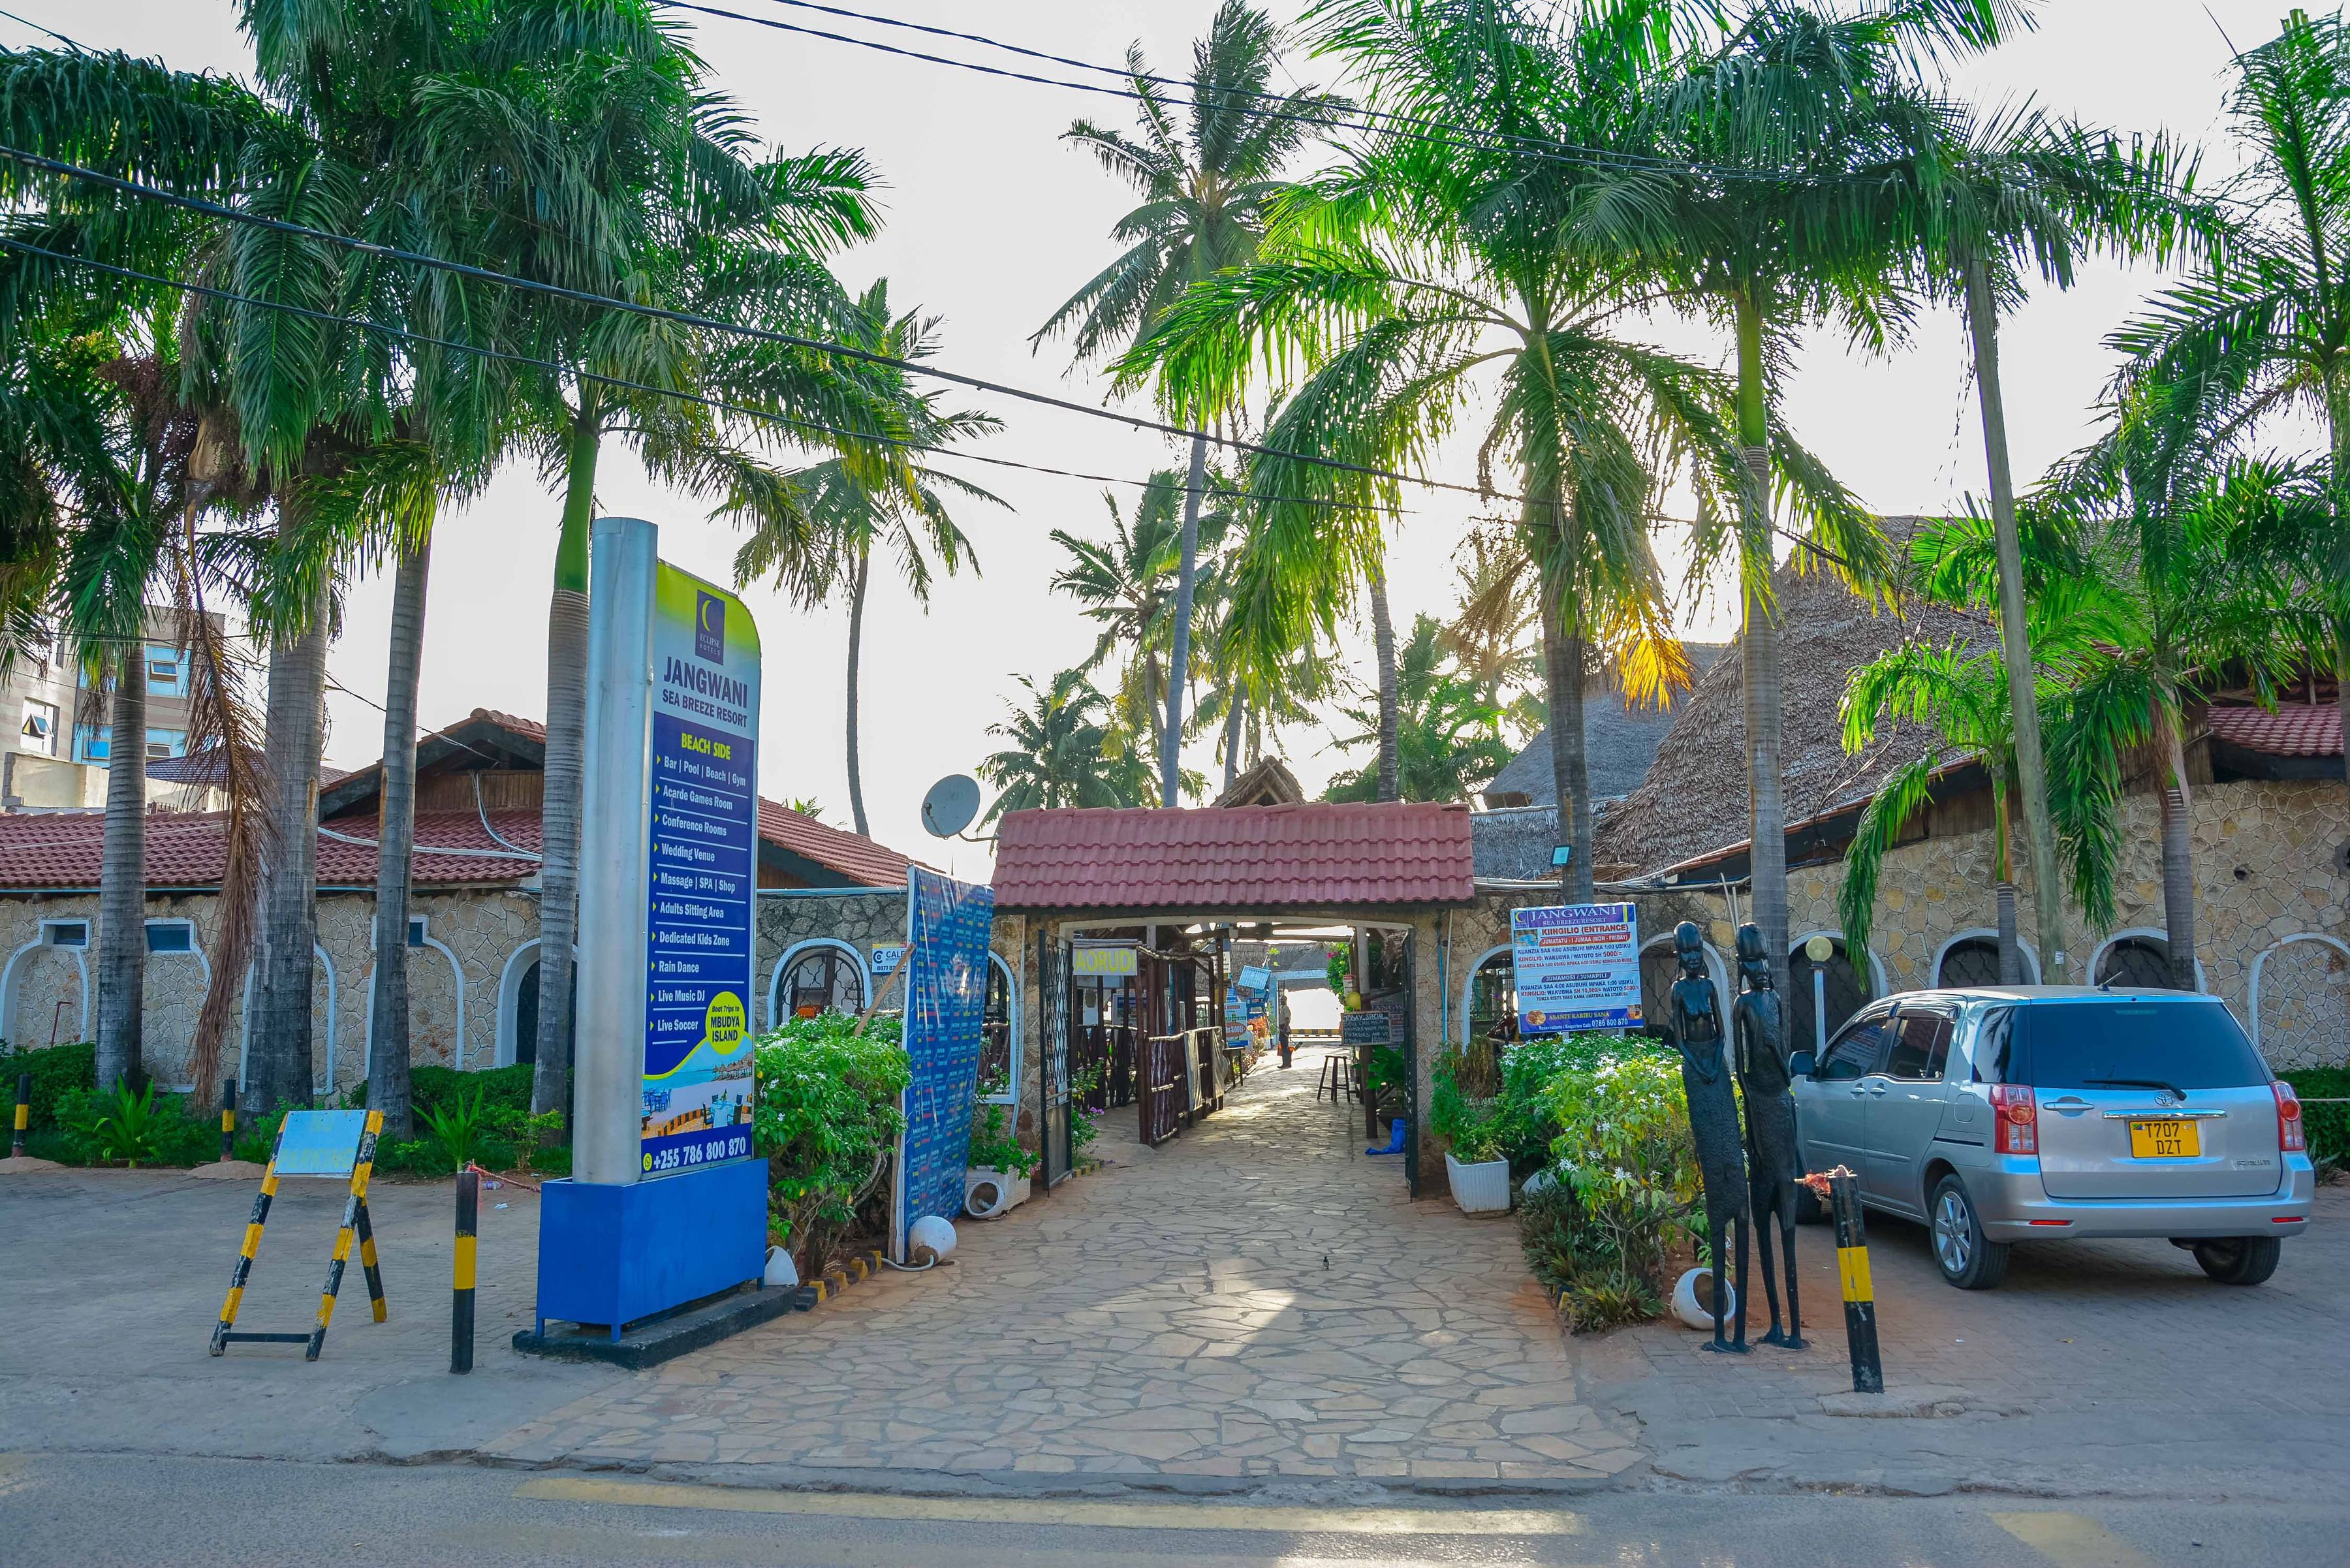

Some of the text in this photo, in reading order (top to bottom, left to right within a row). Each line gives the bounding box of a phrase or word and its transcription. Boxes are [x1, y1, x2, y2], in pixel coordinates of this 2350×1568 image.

[700, 633, 721, 648] ECLIPSE
[700, 644, 720, 655] HOTELS
[664, 656, 747, 709] JANGWANI
[663, 689, 747, 727] SEA BREEZE RESORT
[682, 732, 731, 760] BEACH SIDE
[665, 756, 676, 769] Bar
[683, 760, 699, 775] Pool
[706, 766, 726, 781] Beach
[732, 774, 745, 787] Gym
[663, 785, 732, 810] Acarde Games Room
[663, 814, 727, 836] Conference Rooms
[662, 843, 715, 862] Wedding Venue
[661, 872, 693, 889] Massage
[699, 877, 713, 890] SPA
[719, 880, 736, 894] Shop
[660, 902, 724, 919] Adults Sitting Area
[1531, 907, 1617, 922] JANGWANI
[1582, 924, 1628, 934] (ENTRANCE)
[659, 931, 730, 947] Dedicated Kids Zone
[659, 960, 699, 973] Rain Dance
[658, 990, 705, 1002] Live Music DJ
[724, 1005, 734, 1013] Trips
[657, 1019, 698, 1031] Live Soccer
[711, 1016, 740, 1028] MBUDYA
[712, 1030, 738, 1042] ISLAND
[2144, 1123, 2179, 1138] T707
[653, 1137, 746, 1170] +255 786 800 870
[2155, 1140, 2182, 1155] DZT
